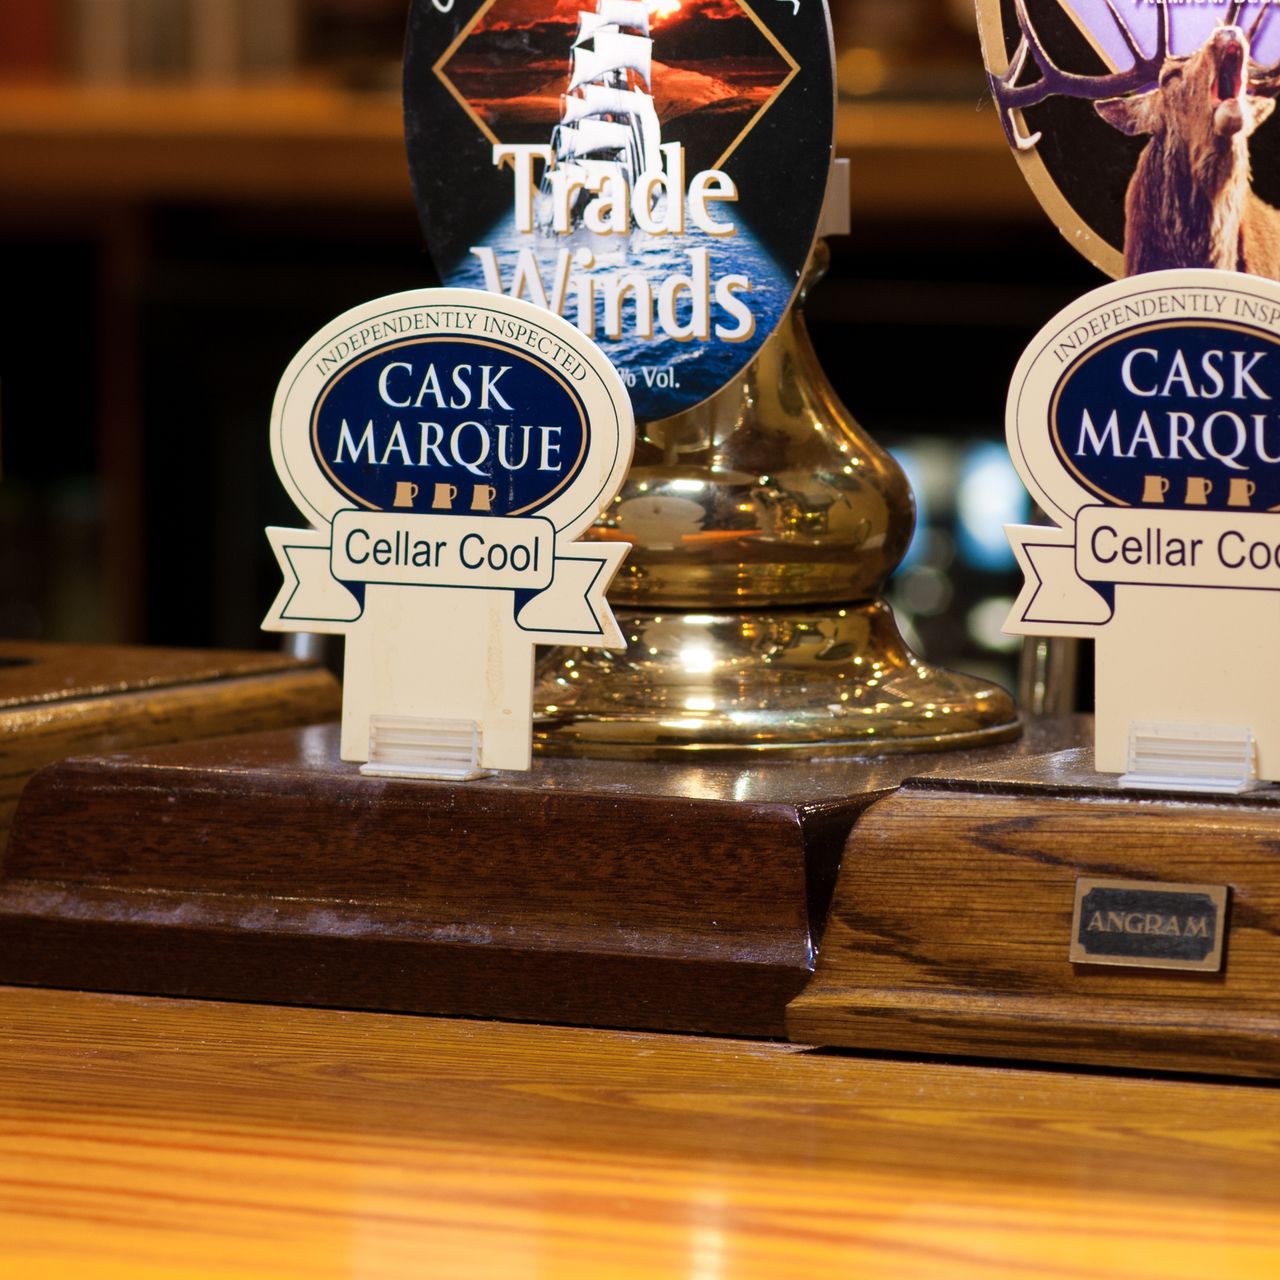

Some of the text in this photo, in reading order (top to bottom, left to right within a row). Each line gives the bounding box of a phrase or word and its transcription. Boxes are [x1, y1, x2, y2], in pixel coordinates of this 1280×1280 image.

[492, 141, 740, 237] Trade
[470, 246, 756, 343] Winds
[315, 311, 588, 382] INDEPENDENTLY INSPECTED
[1052, 294, 1227, 364] INDEPENDENTLY
[377, 362, 515, 411] CASK
[641, 365, 680, 388] Vol.
[1121, 348, 1272, 400] CASK
[333, 418, 563, 477] MARQUE
[345, 528, 539, 572] Cellar Cool
[1090, 525, 1204, 567] Cellar
[1086, 910, 1209, 938] ANGRAM
